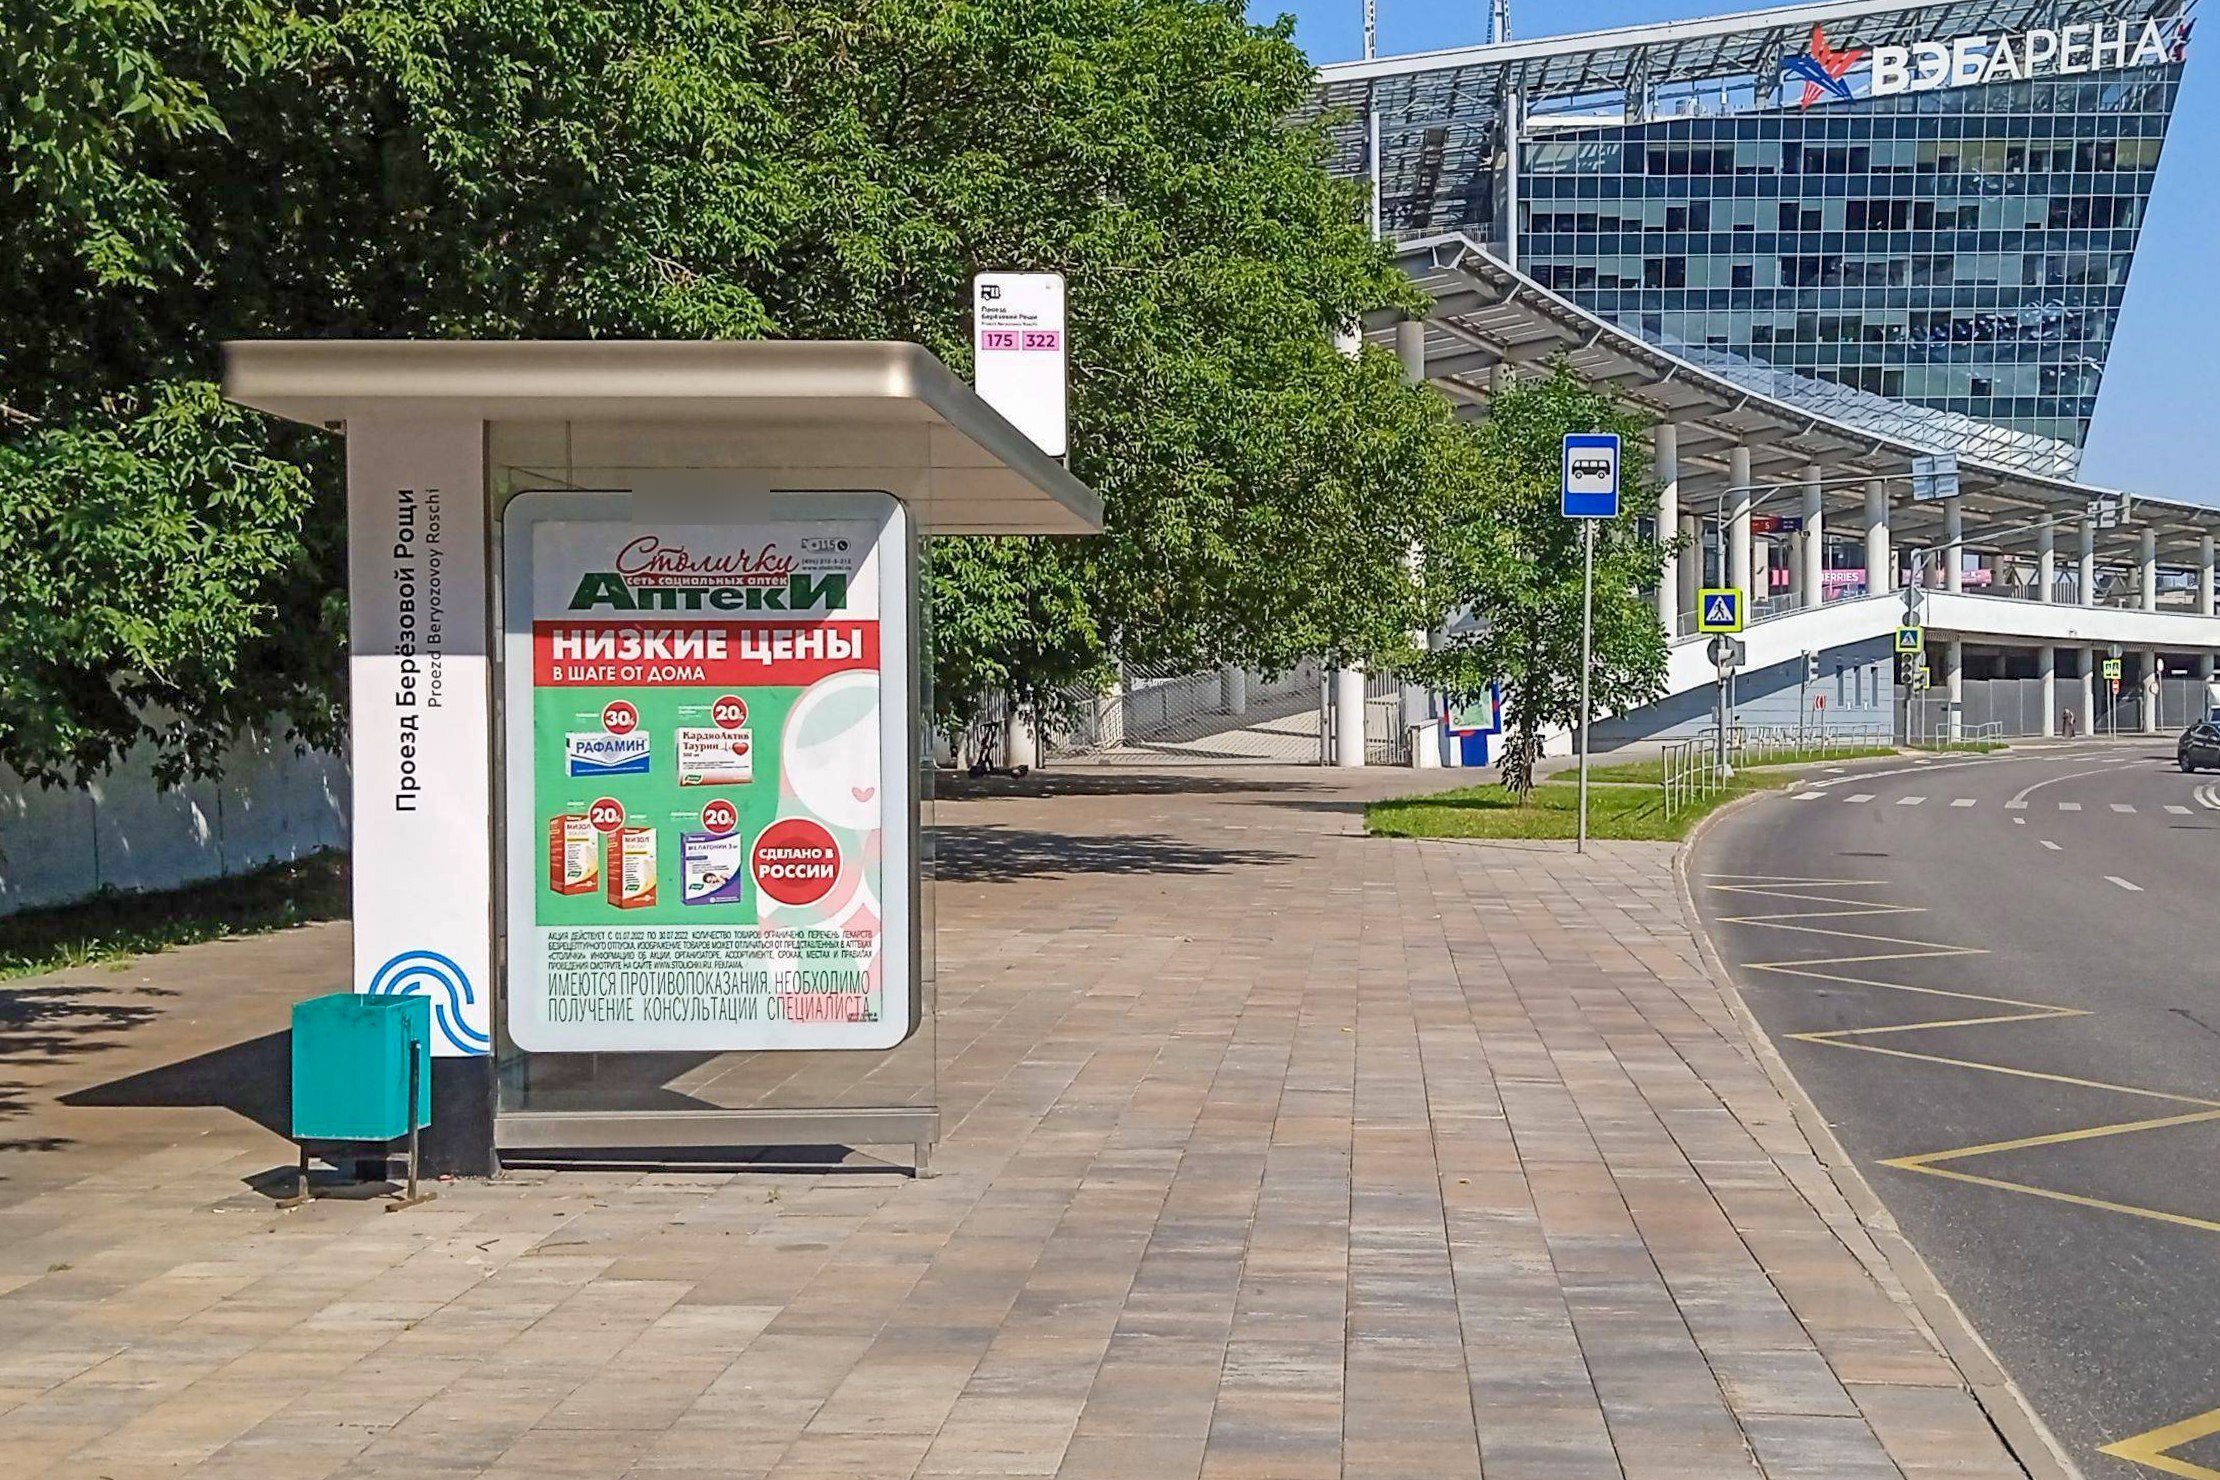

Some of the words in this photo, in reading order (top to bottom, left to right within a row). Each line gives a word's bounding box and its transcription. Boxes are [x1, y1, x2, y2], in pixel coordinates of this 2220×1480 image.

[1870, 15, 2169, 97] ВЭБАРЕНА
[987, 334, 1013, 347] 175
[1026, 334, 1055, 347] 322
[394, 489, 418, 559] Рощи
[425, 488, 440, 544] Roschi
[616, 535, 800, 575] Столички
[627, 576, 655, 586] сеть
[658, 575, 744, 587] социальных
[747, 575, 788, 586] аптек
[427, 549, 443, 644] Beryozovoy
[394, 567, 421, 707] Берёзовой
[552, 629, 728, 661] НИЗКИЕ
[741, 628, 863, 666] ЦЕНЫ
[428, 650, 442, 708] Proezd
[553, 666, 563, 681] В
[568, 666, 616, 681] ШАГЕ
[620, 666, 644, 681] ОТ
[647, 666, 706, 682] ДОМА
[576, 740, 645, 754] РАФАМИН
[682, 731, 750, 742] КардиоАктив
[682, 741, 719, 753] Таурин
[396, 714, 421, 811] Проезд
[759, 848, 822, 861] СДЕЛАНО
[825, 848, 834, 859] В
[759, 864, 834, 879] РОССИИ
[549, 971, 616, 996] ИМЕЮТСЯ
[621, 970, 771, 996] ПРОТИВОПОКАЗАНИЯ.
[775, 970, 870, 996] НЕОБХОДИМО
[549, 997, 634, 1022] ПОЛУЧЕНИЕ
[644, 996, 758, 1024] КОНСУЛЬТАЦИИ
